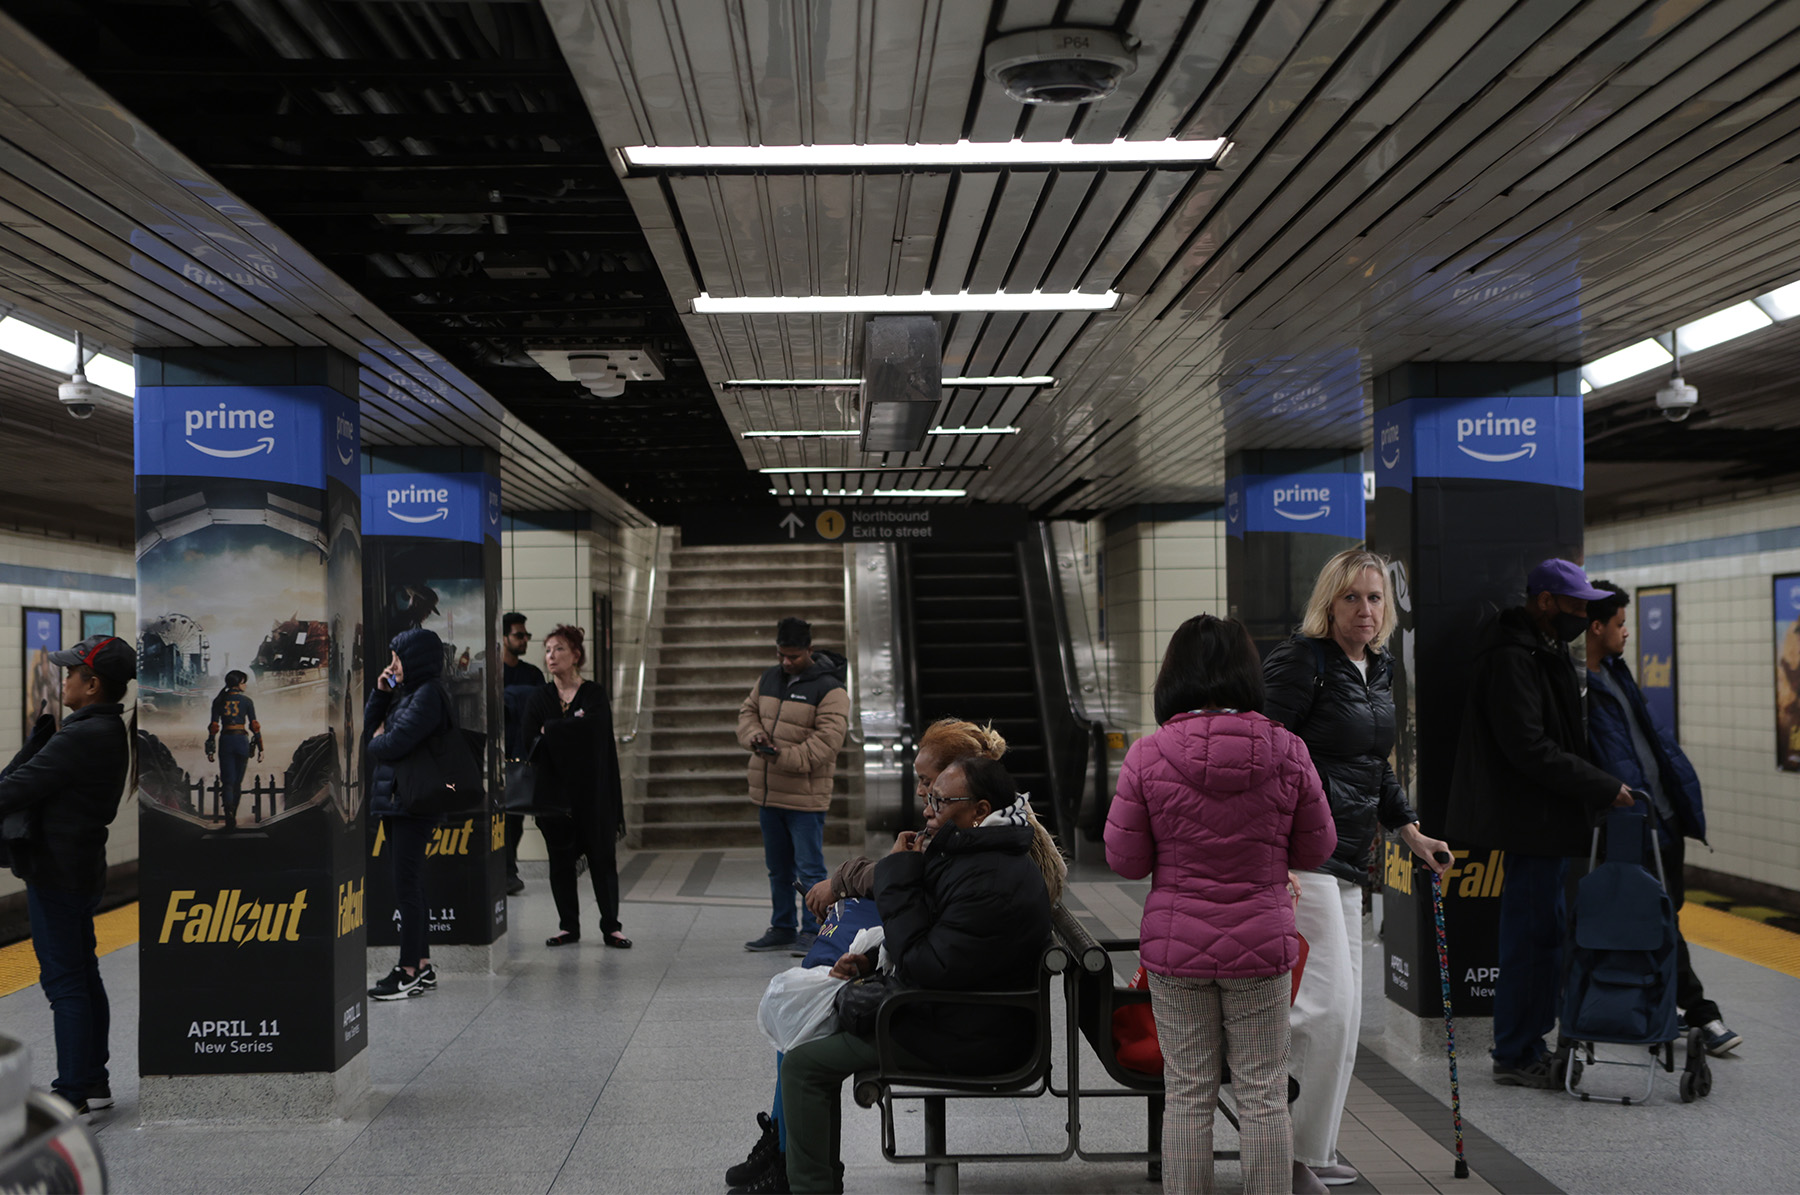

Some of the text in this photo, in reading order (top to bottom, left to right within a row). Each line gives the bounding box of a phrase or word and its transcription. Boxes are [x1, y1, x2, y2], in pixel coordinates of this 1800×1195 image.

[1063, 37, 1090, 49] P64
[185, 402, 275, 436] prime
[337, 411, 354, 441] prime
[1457, 411, 1537, 442] prime
[1381, 421, 1400, 452] prime
[387, 483, 449, 509] prime
[1273, 484, 1330, 507] prime
[825, 517, 834, 532] 1
[852, 510, 930, 522] Northbound
[852, 526, 932, 538] Exit to street
[223, 700, 241, 717] 33
[1440, 849, 1505, 898] Fall
[158, 888, 308, 950] Fallout
[1463, 967, 1501, 983] APR
[187, 1019, 281, 1038] APRIL 11
[194, 1040, 274, 1055] New Series
